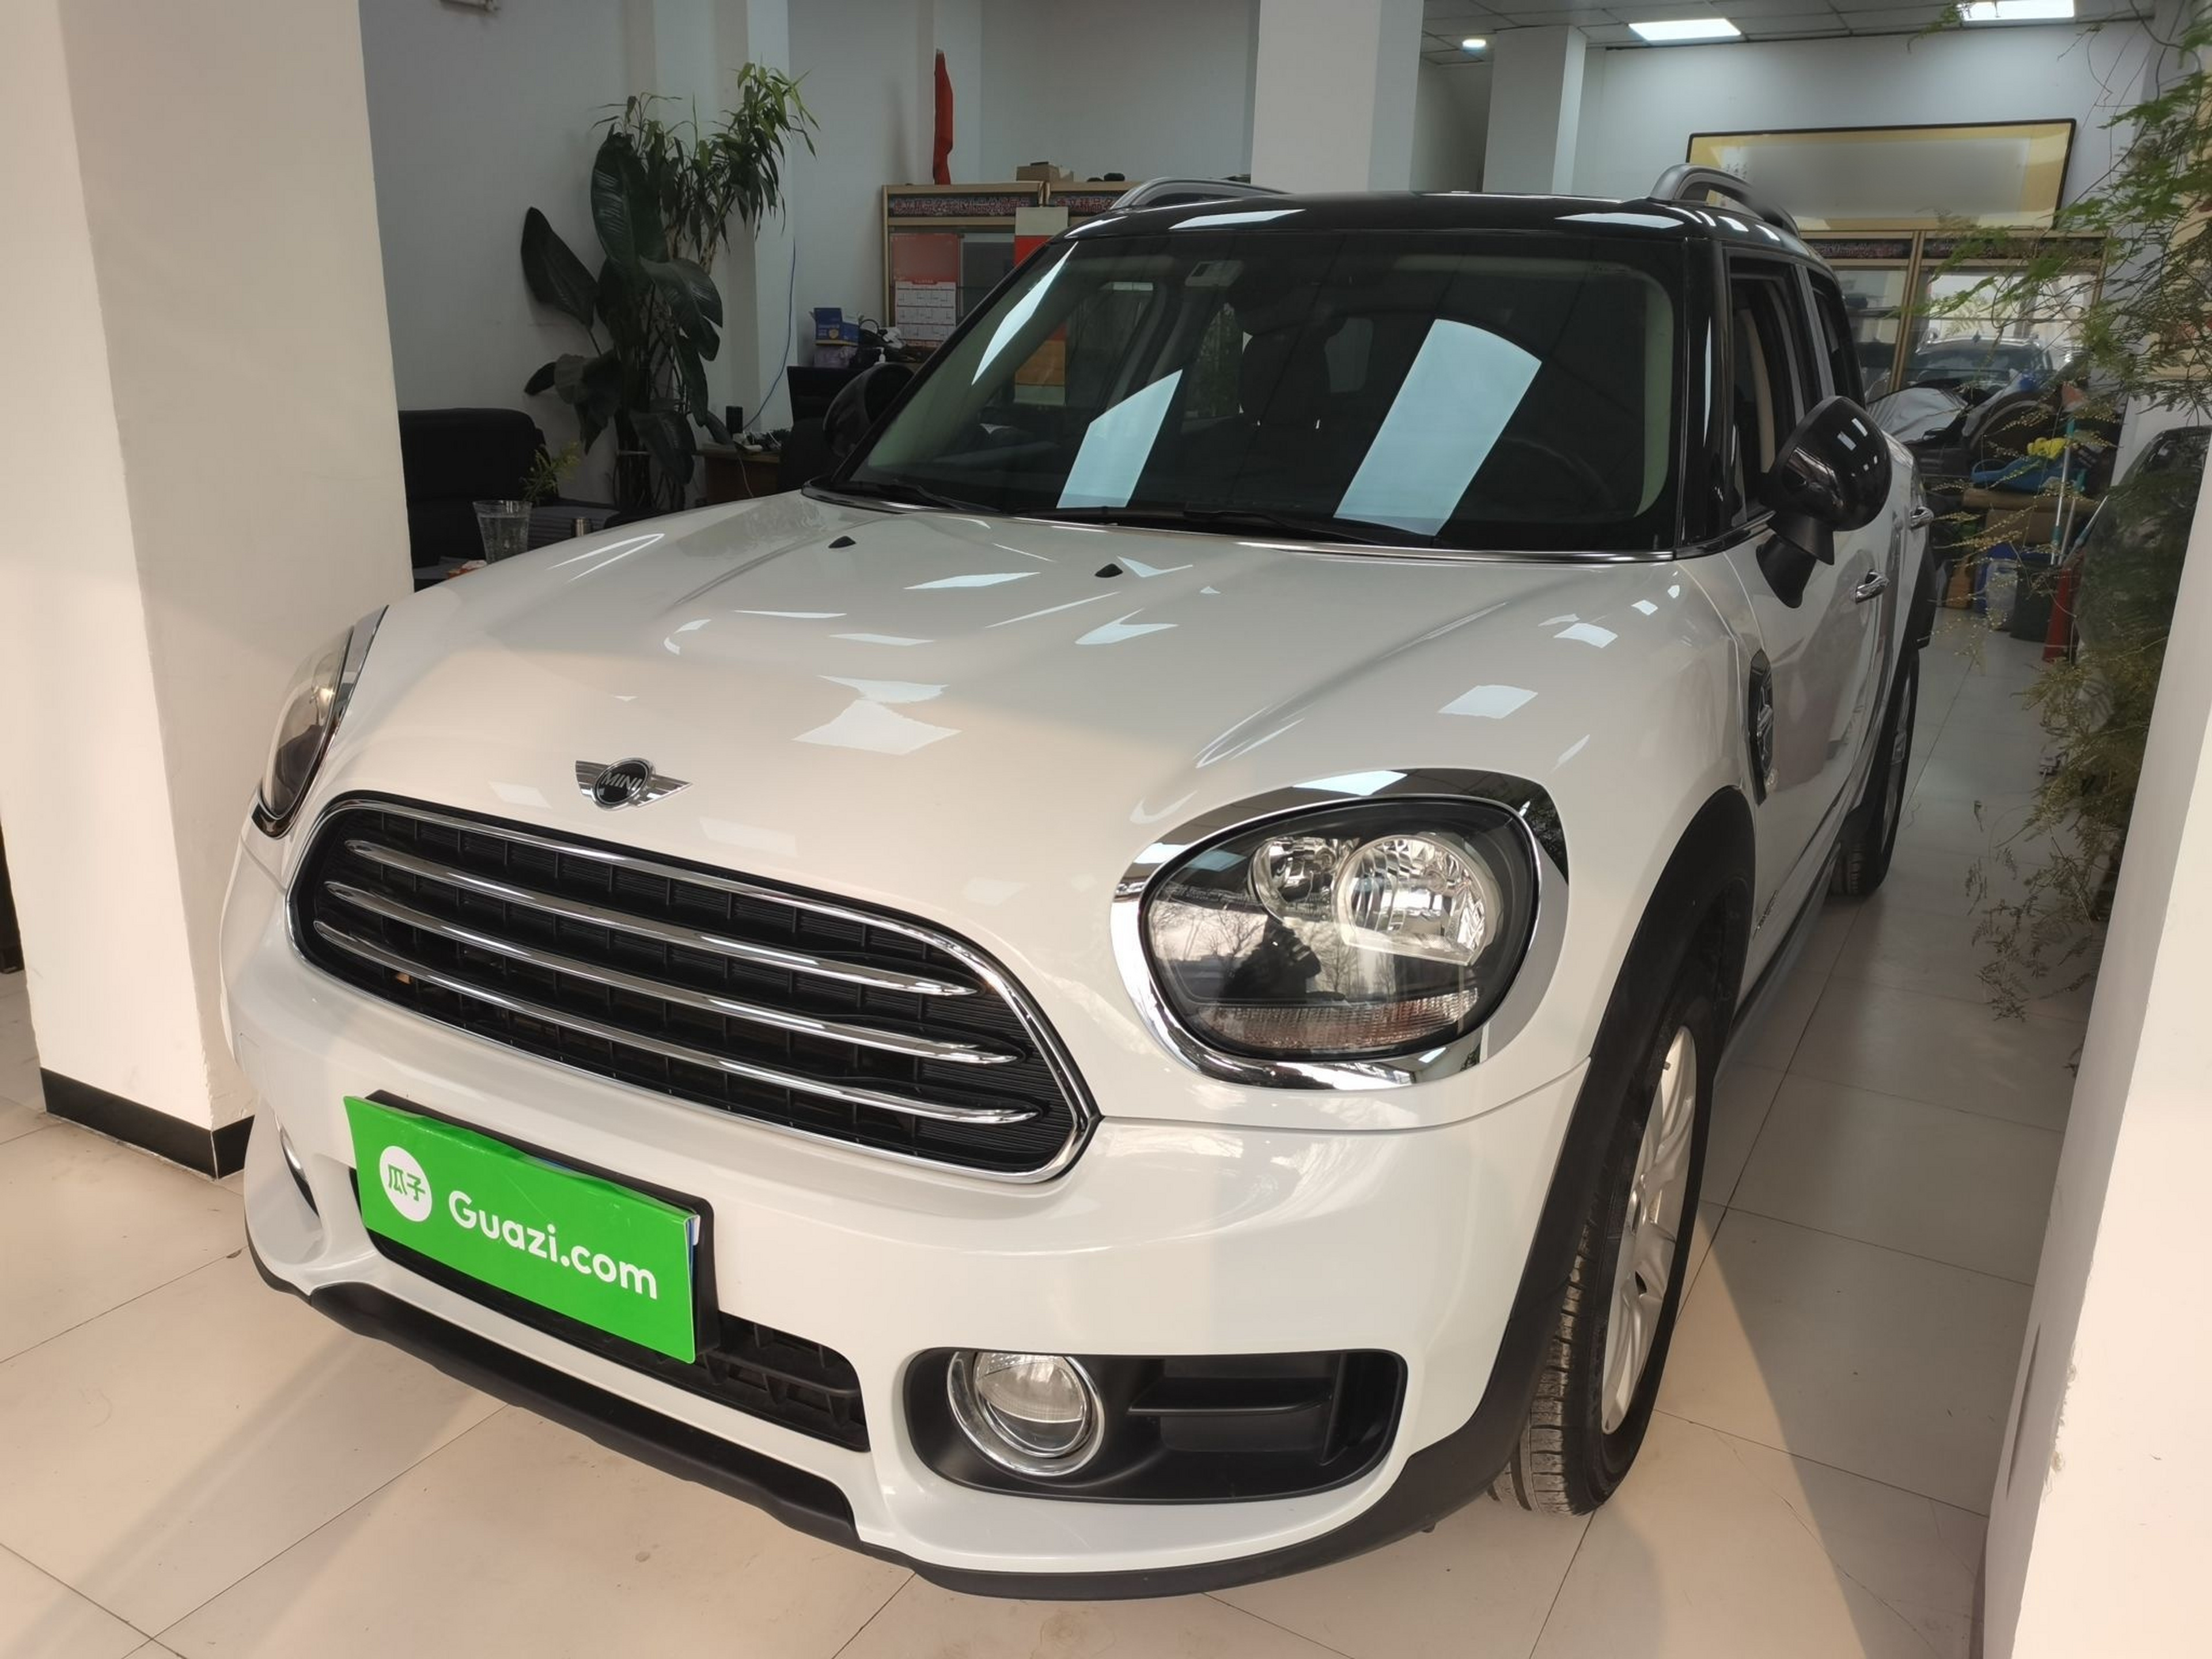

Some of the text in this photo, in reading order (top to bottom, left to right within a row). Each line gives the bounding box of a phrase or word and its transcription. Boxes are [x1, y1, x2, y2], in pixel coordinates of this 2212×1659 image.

[601, 772, 642, 791] MINI
[388, 1165, 425, 1201] 瓜子
[449, 1191, 657, 1300] Guazi.com
